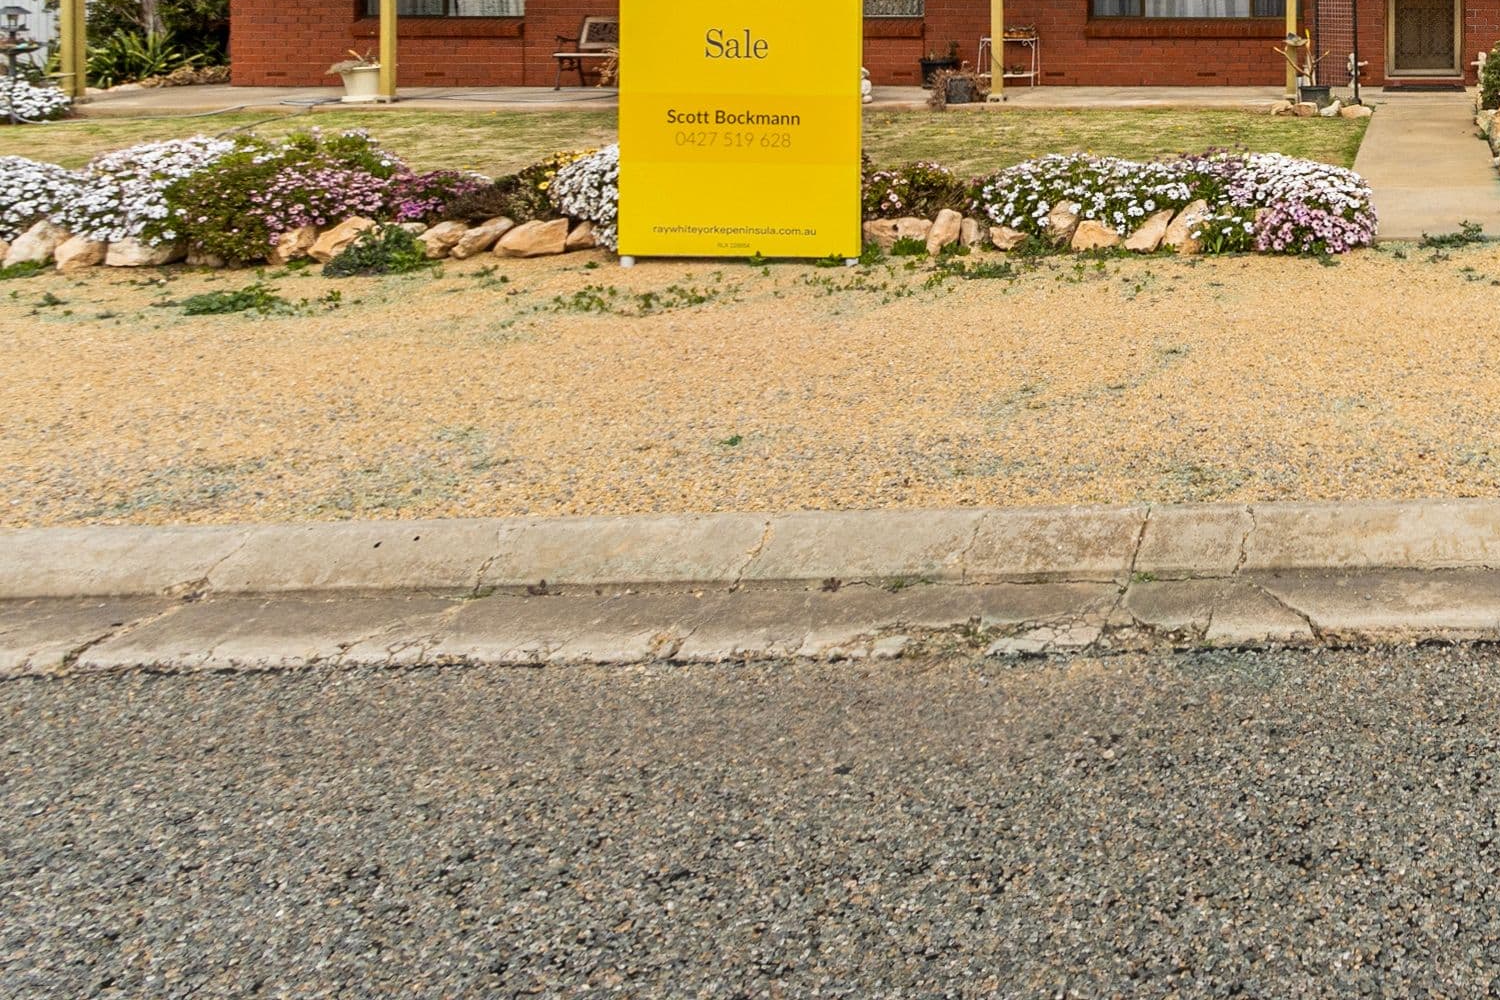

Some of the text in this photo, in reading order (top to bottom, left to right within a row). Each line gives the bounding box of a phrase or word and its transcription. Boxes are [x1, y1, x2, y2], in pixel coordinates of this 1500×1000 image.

[704, 28, 769, 59] Sale
[666, 108, 801, 126] Scott Bockmann
[675, 131, 792, 149] 0427 519 628
[652, 224, 817, 237] raywhiteyorkepeninsula.com.au
